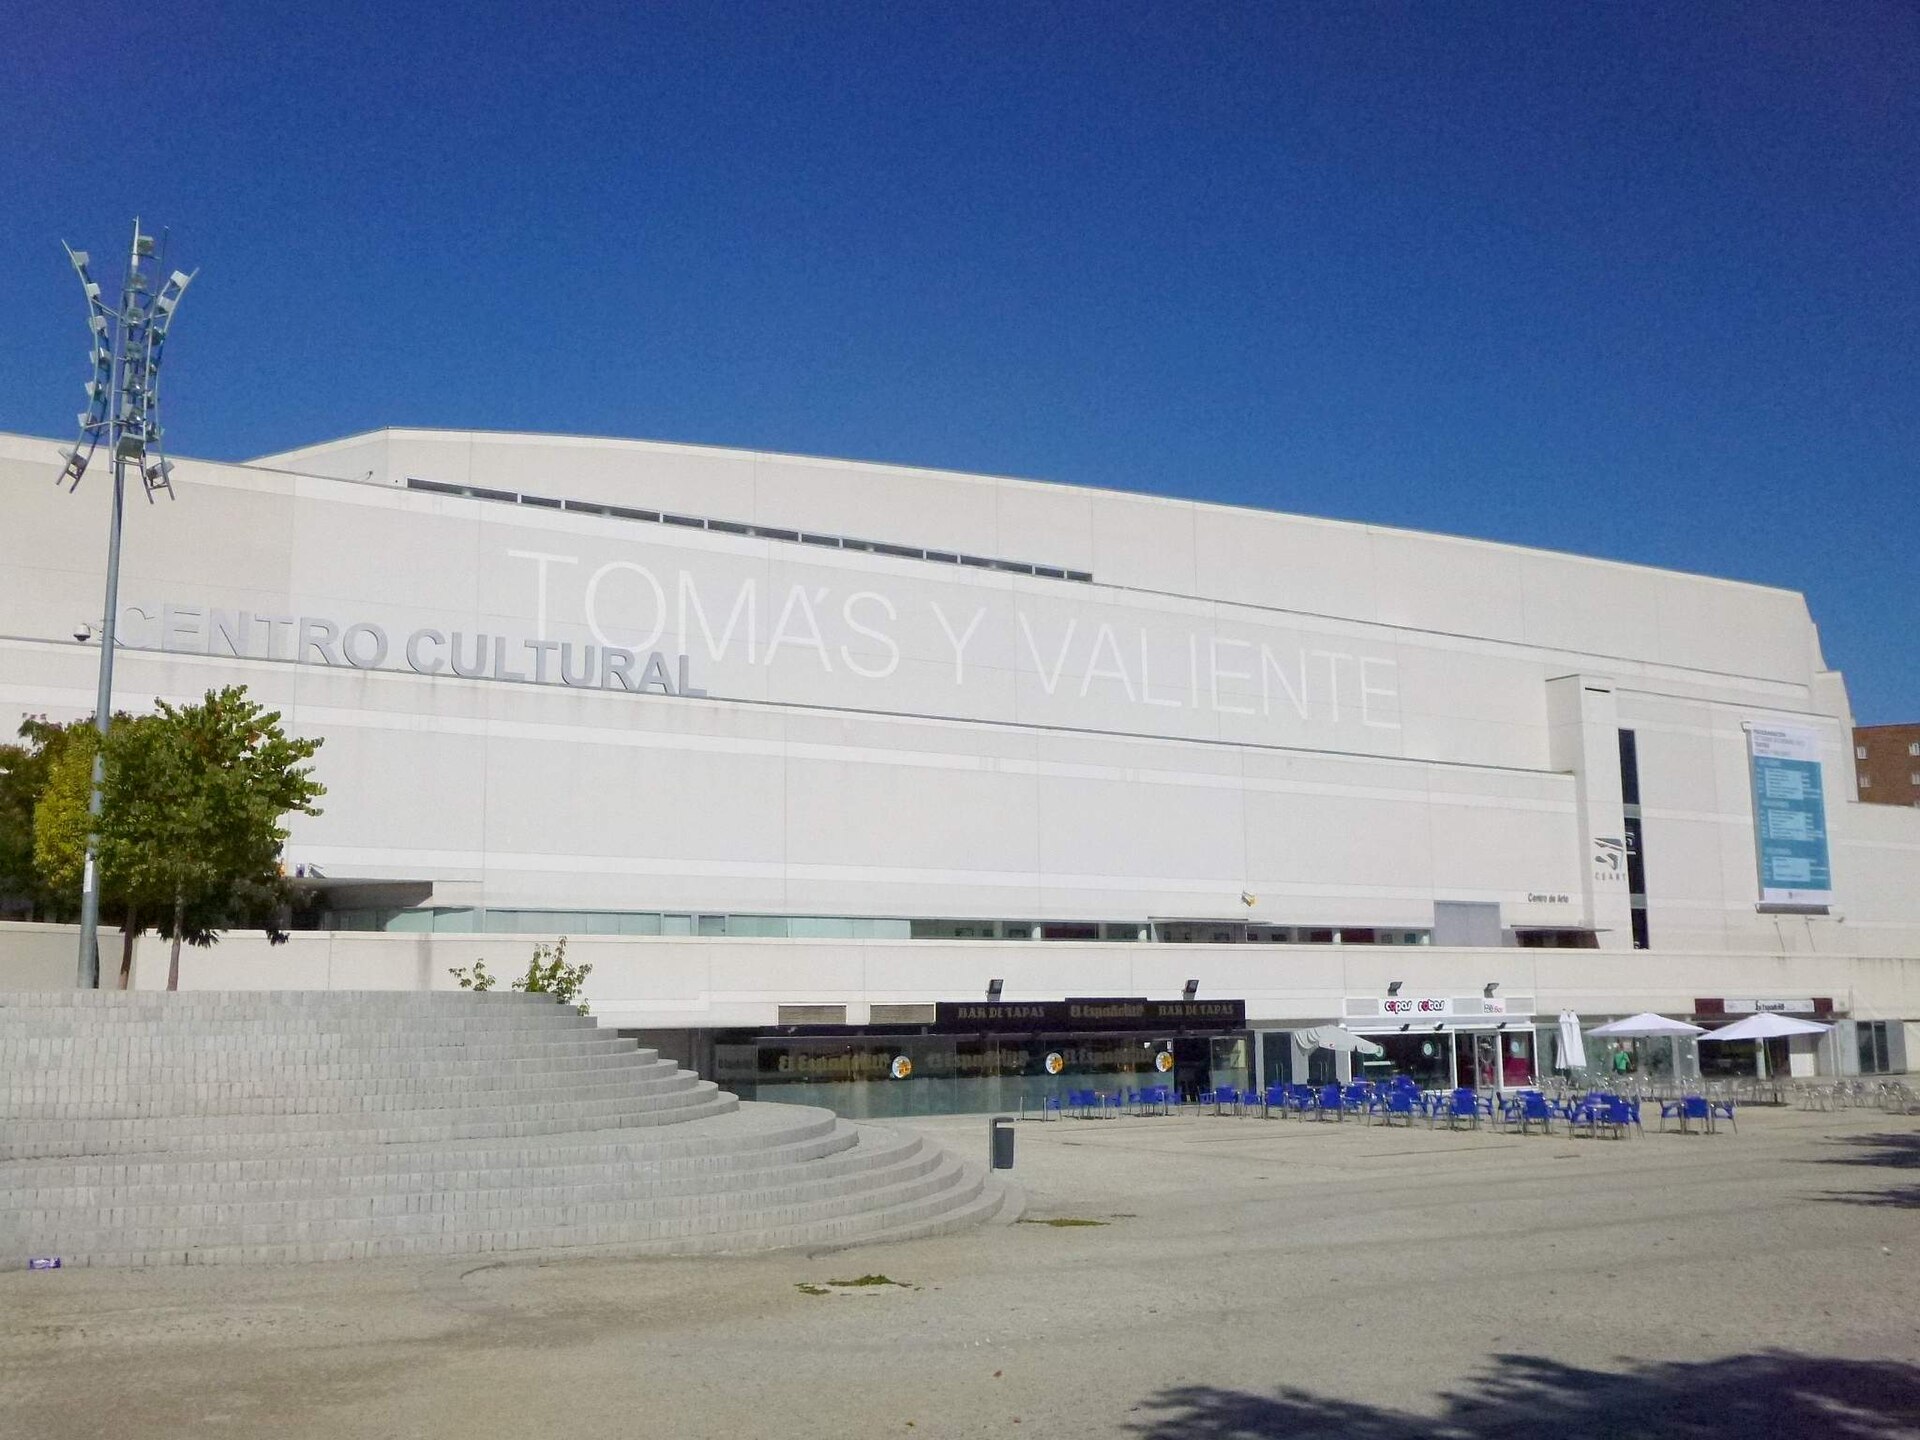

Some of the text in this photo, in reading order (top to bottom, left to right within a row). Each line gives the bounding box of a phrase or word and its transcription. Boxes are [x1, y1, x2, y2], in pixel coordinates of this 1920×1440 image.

[112, 603, 709, 697] CENTRO CULTURAL
[507, 549, 1402, 730] TOMÁS Y VALIENTE
[958, 1005, 1045, 1018] BAR DE TAPAS
[1159, 1004, 1234, 1016] BAR DE TAPAS
